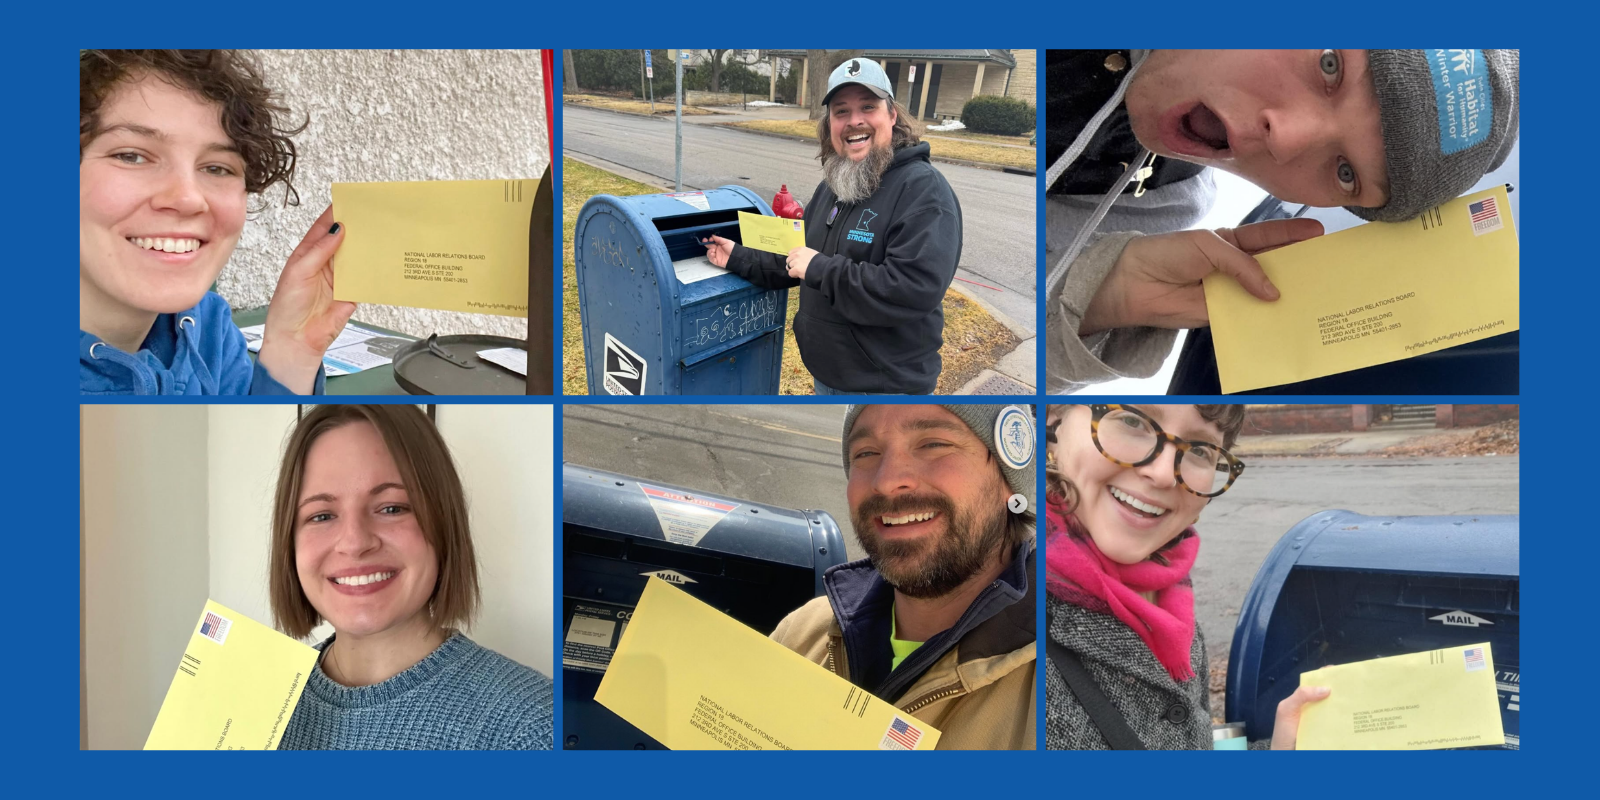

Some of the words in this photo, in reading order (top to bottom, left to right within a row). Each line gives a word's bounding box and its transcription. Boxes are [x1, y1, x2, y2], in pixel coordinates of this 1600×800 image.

[1435, 49, 1450, 88] Winter
[1446, 91, 1457, 138] Warrior
[1465, 79, 1479, 136] Habitat
[1474, 217, 1500, 231] FREEDOM
[847, 234, 873, 243] STRONG
[849, 229, 874, 237] MINNESOTA
[1318, 312, 1345, 323] NATIONAL
[1346, 307, 1364, 316] LABOR
[1365, 298, 1395, 310] RELATIONS
[1396, 292, 1415, 302] BOARD
[1319, 320, 1340, 328] REGION
[1320, 325, 1345, 334] FEDERAL
[1347, 318, 1366, 328] OFFICE
[1367, 312, 1393, 323] BUILDING
[1322, 332, 1360, 346] MINNEAPOLIS
[662, 492, 716, 507] ATTTION
[656, 573, 681, 582] MAIL
[1446, 615, 1474, 625] MAIL
[697, 701, 717, 716] REGION
[222, 718, 232, 736] BOARD
[695, 707, 717, 724] FEDERAL
[718, 721, 737, 736] OFFICE
[738, 733, 762, 750] BUILDING
[700, 695, 724, 713] NATIONAL
[725, 710, 743, 724] LABOR
[744, 721, 774, 742] RELATIONS
[774, 739, 793, 750] BOAR
[690, 719, 723, 743] MINNEAPOLIS
[723, 740, 732, 749] MN
[692, 713, 701, 721] 212
[701, 718, 712, 728] 3RD
[712, 726, 723, 735] AVE
[728, 735, 739, 745] STE
[739, 742, 748, 750] 200
[883, 736, 906, 750] FREED
